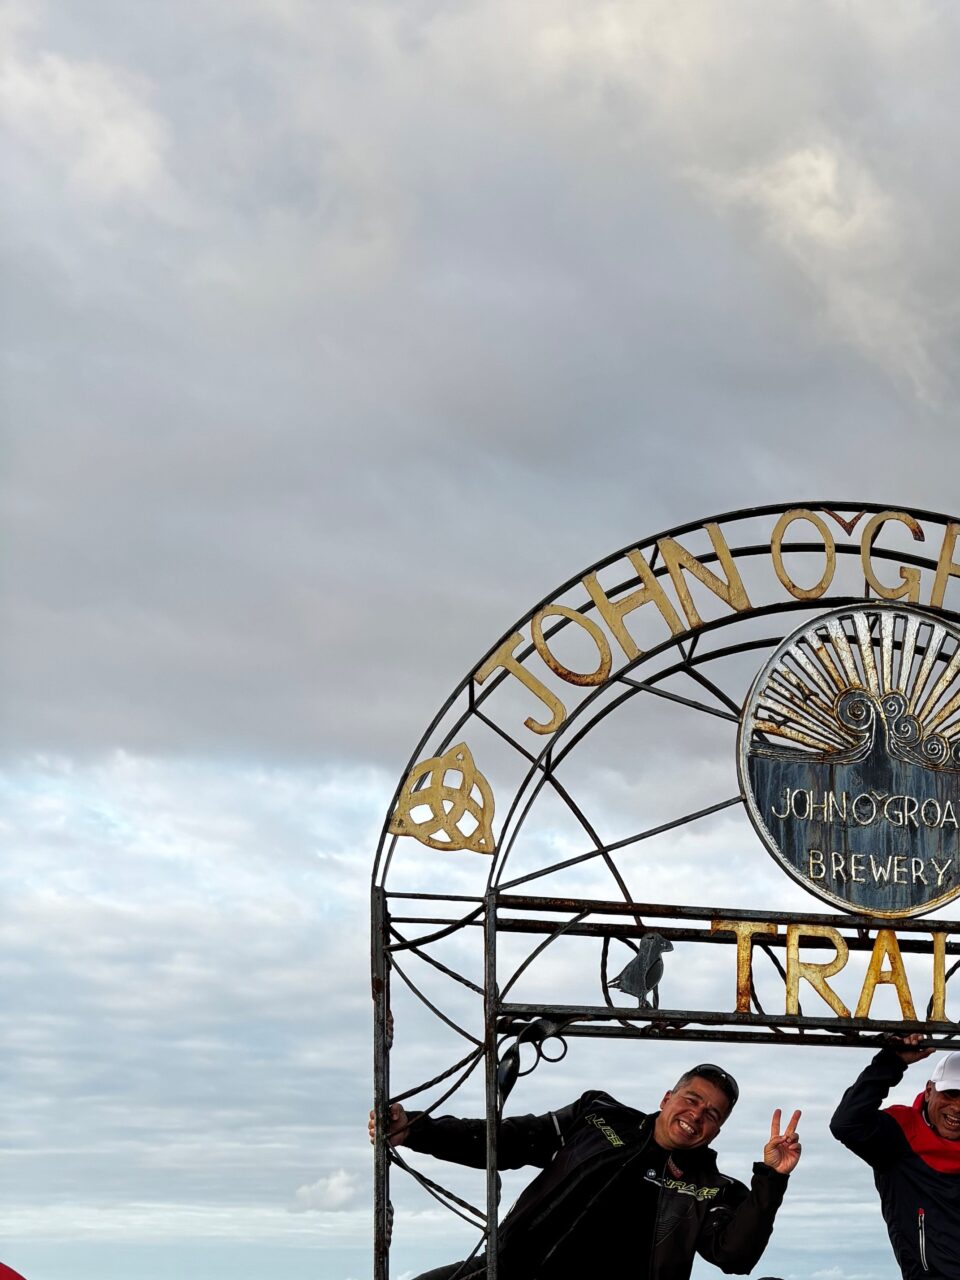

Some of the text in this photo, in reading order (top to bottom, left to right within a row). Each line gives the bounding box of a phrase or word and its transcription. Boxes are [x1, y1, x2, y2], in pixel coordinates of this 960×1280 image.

[473, 521, 753, 736] JOHN
[771, 787, 847, 823] JOHN
[809, 849, 953, 887] BREWERY
